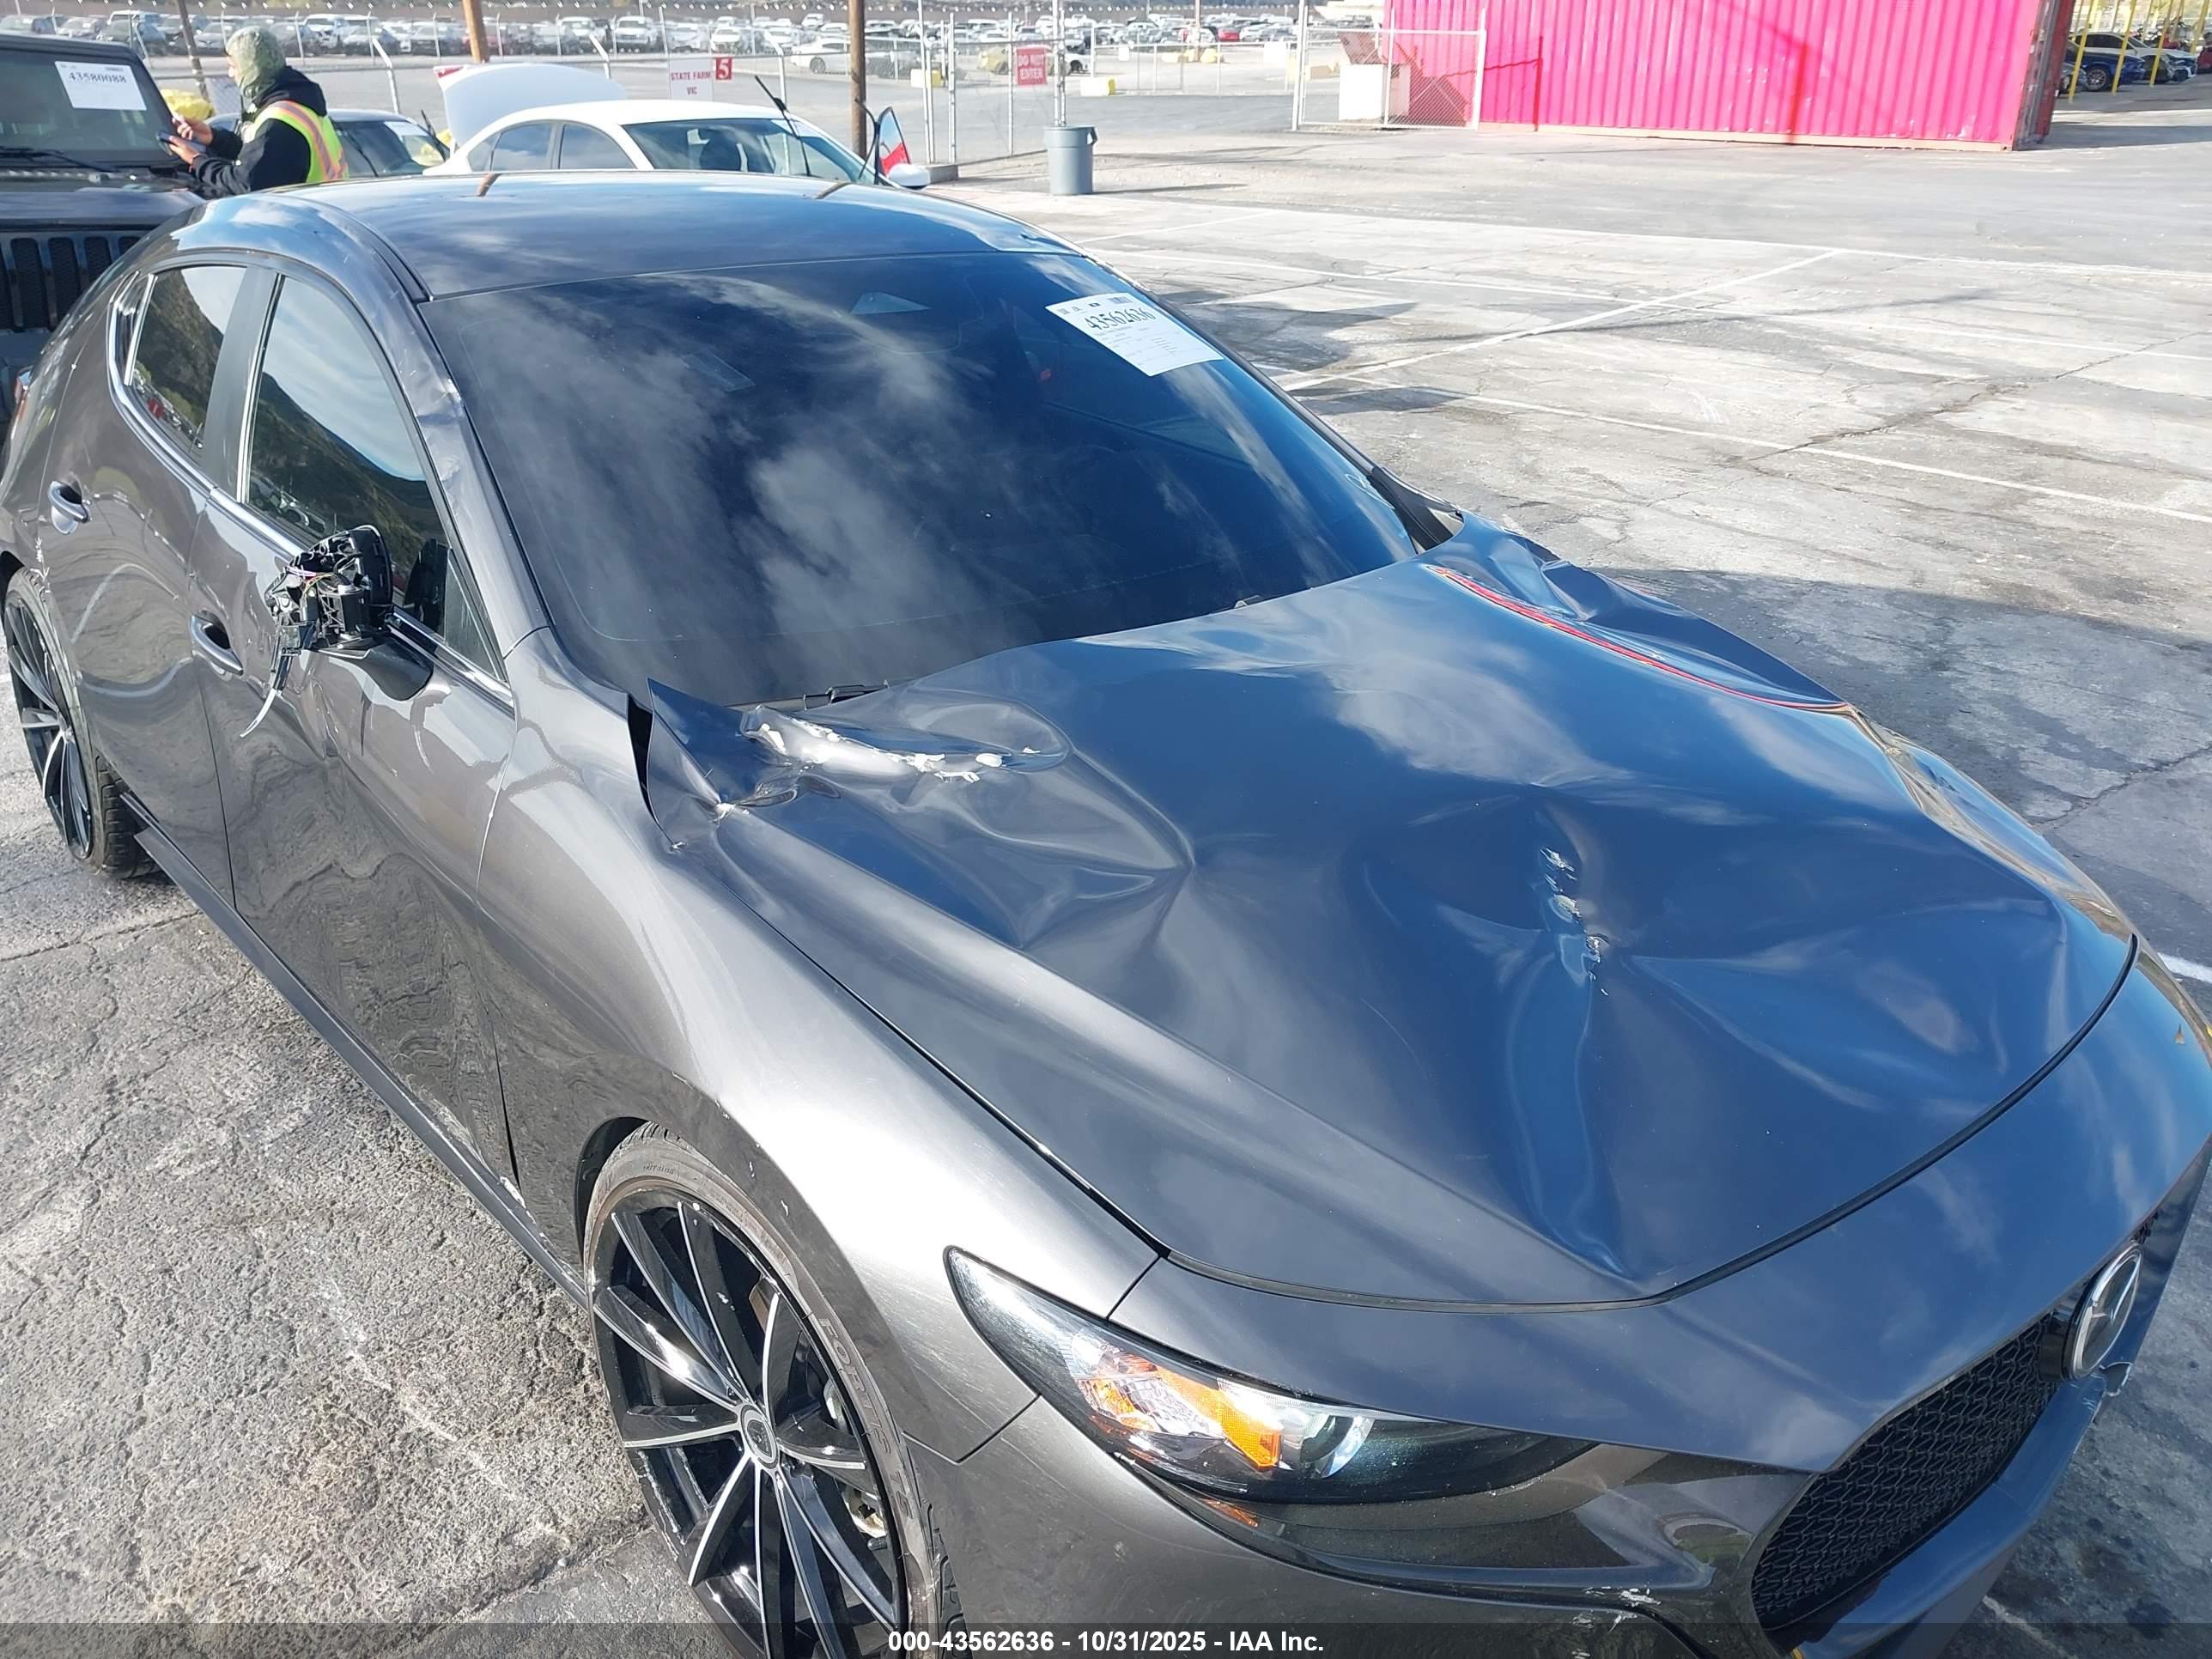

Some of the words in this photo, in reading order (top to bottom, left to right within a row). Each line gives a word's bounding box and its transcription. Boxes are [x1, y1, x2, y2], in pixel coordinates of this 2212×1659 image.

[671, 71, 690, 81] STATE
[692, 70, 712, 80] FARM
[718, 58, 729, 79] 5
[1019, 68, 1044, 79] ENTER
[1084, 307, 1156, 330] 43562636
